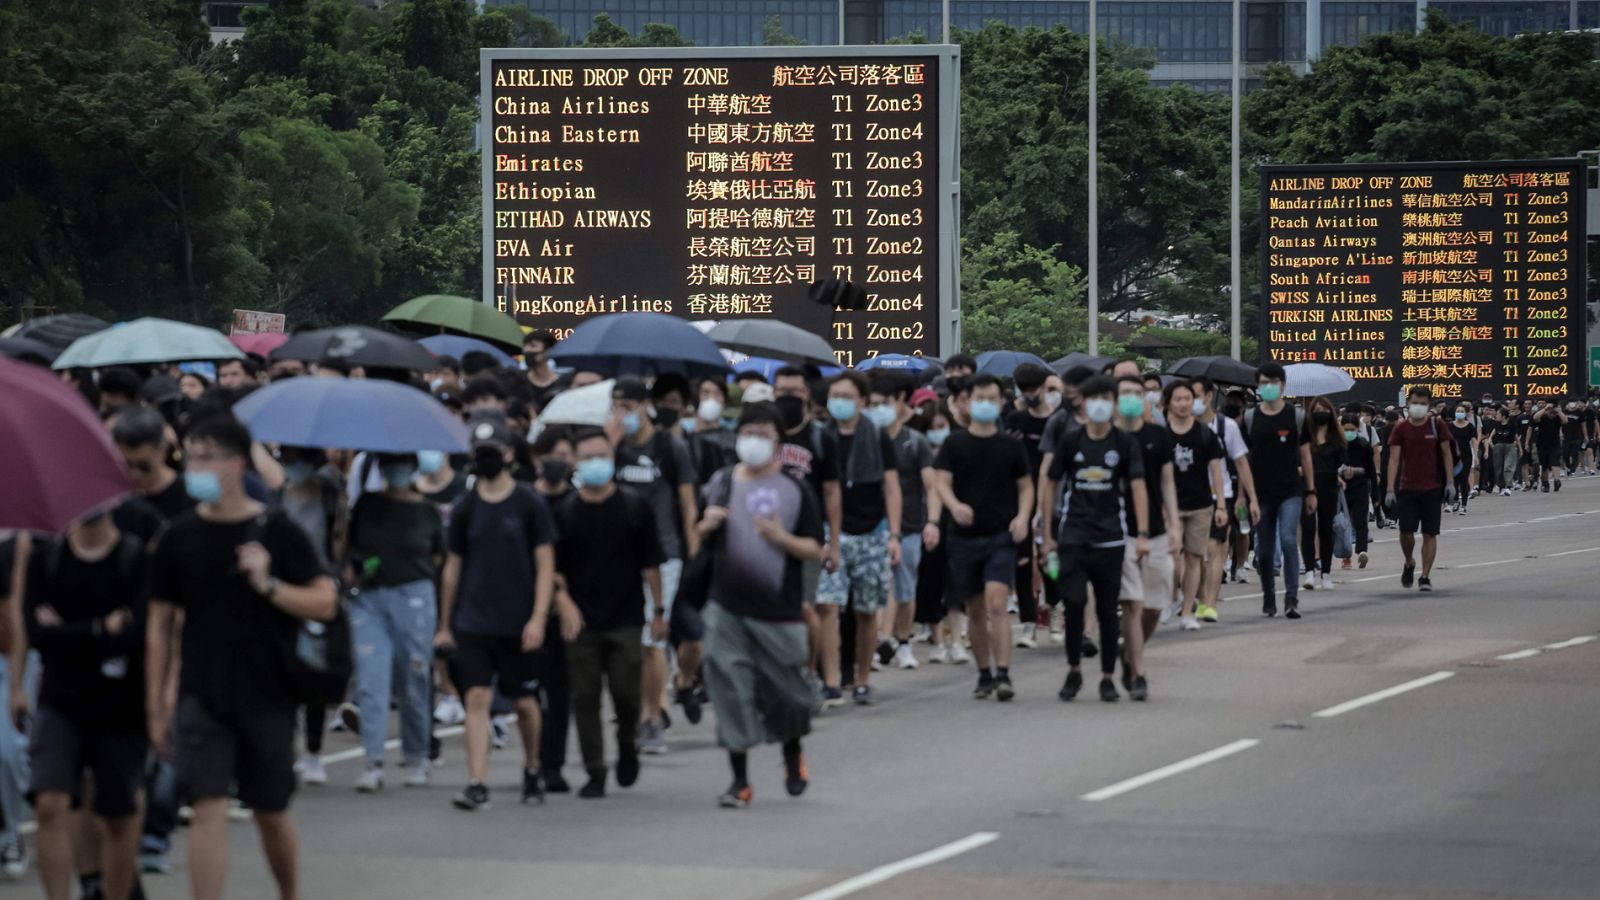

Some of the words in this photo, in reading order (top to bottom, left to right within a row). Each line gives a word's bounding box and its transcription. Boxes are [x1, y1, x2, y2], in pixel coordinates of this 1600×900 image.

[495, 69, 573, 86] AIRLINE
[584, 68, 629, 86] DROP
[639, 68, 672, 85] OFF
[683, 68, 728, 85] ZONE
[773, 64, 924, 86] 航空公司落客區
[495, 97, 551, 114] China
[562, 96, 649, 114] Airlines
[688, 94, 771, 115] 中華航空
[832, 95, 852, 112] T1
[866, 94, 922, 111] Zone3
[495, 126, 551, 143] China
[562, 126, 639, 142] Eastern
[688, 122, 814, 144] 中國東方航空
[832, 124, 852, 140] T1
[866, 122, 923, 140] Zone4
[496, 154, 583, 171] Emirates
[687, 151, 793, 172] 阿聯酋航空
[832, 153, 852, 169] T1
[866, 151, 922, 169] Zone3
[496, 182, 596, 201] Ethiopian
[686, 179, 816, 200] 埃賽俄比亞航
[832, 181, 852, 197] T1
[867, 179, 922, 197] Zone3
[1270, 178, 1324, 190] AIRLINE
[1332, 177, 1363, 189] DROP
[1370, 177, 1393, 188] OFF
[1400, 176, 1432, 188] ZONE
[1464, 172, 1569, 187] 航空公司落客區
[1270, 196, 1392, 209] MandarinAirlines
[1402, 193, 1492, 208] 華信航空公司
[1504, 193, 1518, 205] T1
[1528, 192, 1568, 204] Zone3
[496, 210, 564, 228] ETIHAD
[574, 210, 651, 227] AIRWAYS
[687, 207, 815, 229] 阿提哈德航空
[833, 209, 853, 226] T1
[867, 208, 922, 226] Zone3
[1271, 216, 1308, 228] Peach
[1315, 215, 1378, 228] Aviation
[1403, 213, 1462, 227] 樂桃航空
[1504, 213, 1518, 224] T1
[1528, 211, 1568, 224] Zone3
[496, 240, 530, 256] EVA
[541, 239, 573, 256] Air
[687, 236, 815, 257] 長榮航空公司
[833, 238, 853, 254] T1
[867, 237, 922, 254] Zone2
[1270, 236, 1315, 249] Qantas
[1324, 235, 1376, 248] Airways
[1403, 231, 1492, 246] 澳洲航空公司
[1504, 232, 1518, 243] T1
[1528, 231, 1568, 243] Zone4
[1271, 254, 1338, 267] Singapore
[1346, 253, 1393, 265] A'Line
[1403, 250, 1477, 265] 新加坡航空
[1504, 251, 1518, 262] T1
[1528, 249, 1567, 262] Zone3
[496, 267, 574, 285] FINNAIR
[687, 264, 815, 285] 芬蘭航空公司
[833, 265, 853, 281] T1
[867, 265, 923, 282] Zone4
[1271, 273, 1309, 285] South
[1316, 273, 1370, 284] African
[1402, 269, 1492, 284] 南非航空公司
[1504, 270, 1518, 281] T1
[1528, 268, 1567, 281] Zone3
[687, 293, 772, 313] 香港航空
[867, 294, 923, 311] Zone4
[1271, 292, 1309, 304] SWISS
[1316, 291, 1376, 303] Airlines
[1402, 288, 1492, 303] 瑞士國際航空
[1504, 289, 1519, 300] T1
[1528, 288, 1567, 300] Zone3
[1270, 310, 1324, 323] TURKISH
[1331, 309, 1392, 321] AIRLINES
[1402, 307, 1477, 321] 土耳其航空
[1504, 307, 1518, 319] T1
[1528, 307, 1567, 319] Zone2
[833, 323, 853, 339] T1
[867, 322, 923, 339] Zone2
[1270, 330, 1316, 341] United
[1324, 329, 1384, 341] Airlines
[1402, 326, 1492, 341] 美國聯合航空
[1504, 327, 1518, 338] T1
[1528, 326, 1567, 338] Zone3
[833, 350, 853, 368] T1
[1271, 349, 1318, 362] Virgin
[1324, 348, 1385, 360] Atlantic
[1403, 345, 1462, 360] 維珍航空
[1503, 346, 1517, 357] T1
[1528, 345, 1567, 357] Zone2
[1402, 364, 1492, 378] 維珍澳大利亞
[1504, 365, 1518, 376] T1
[1528, 364, 1567, 376] Zone2
[1504, 384, 1518, 395] T1
[1528, 383, 1568, 395] Zone4
